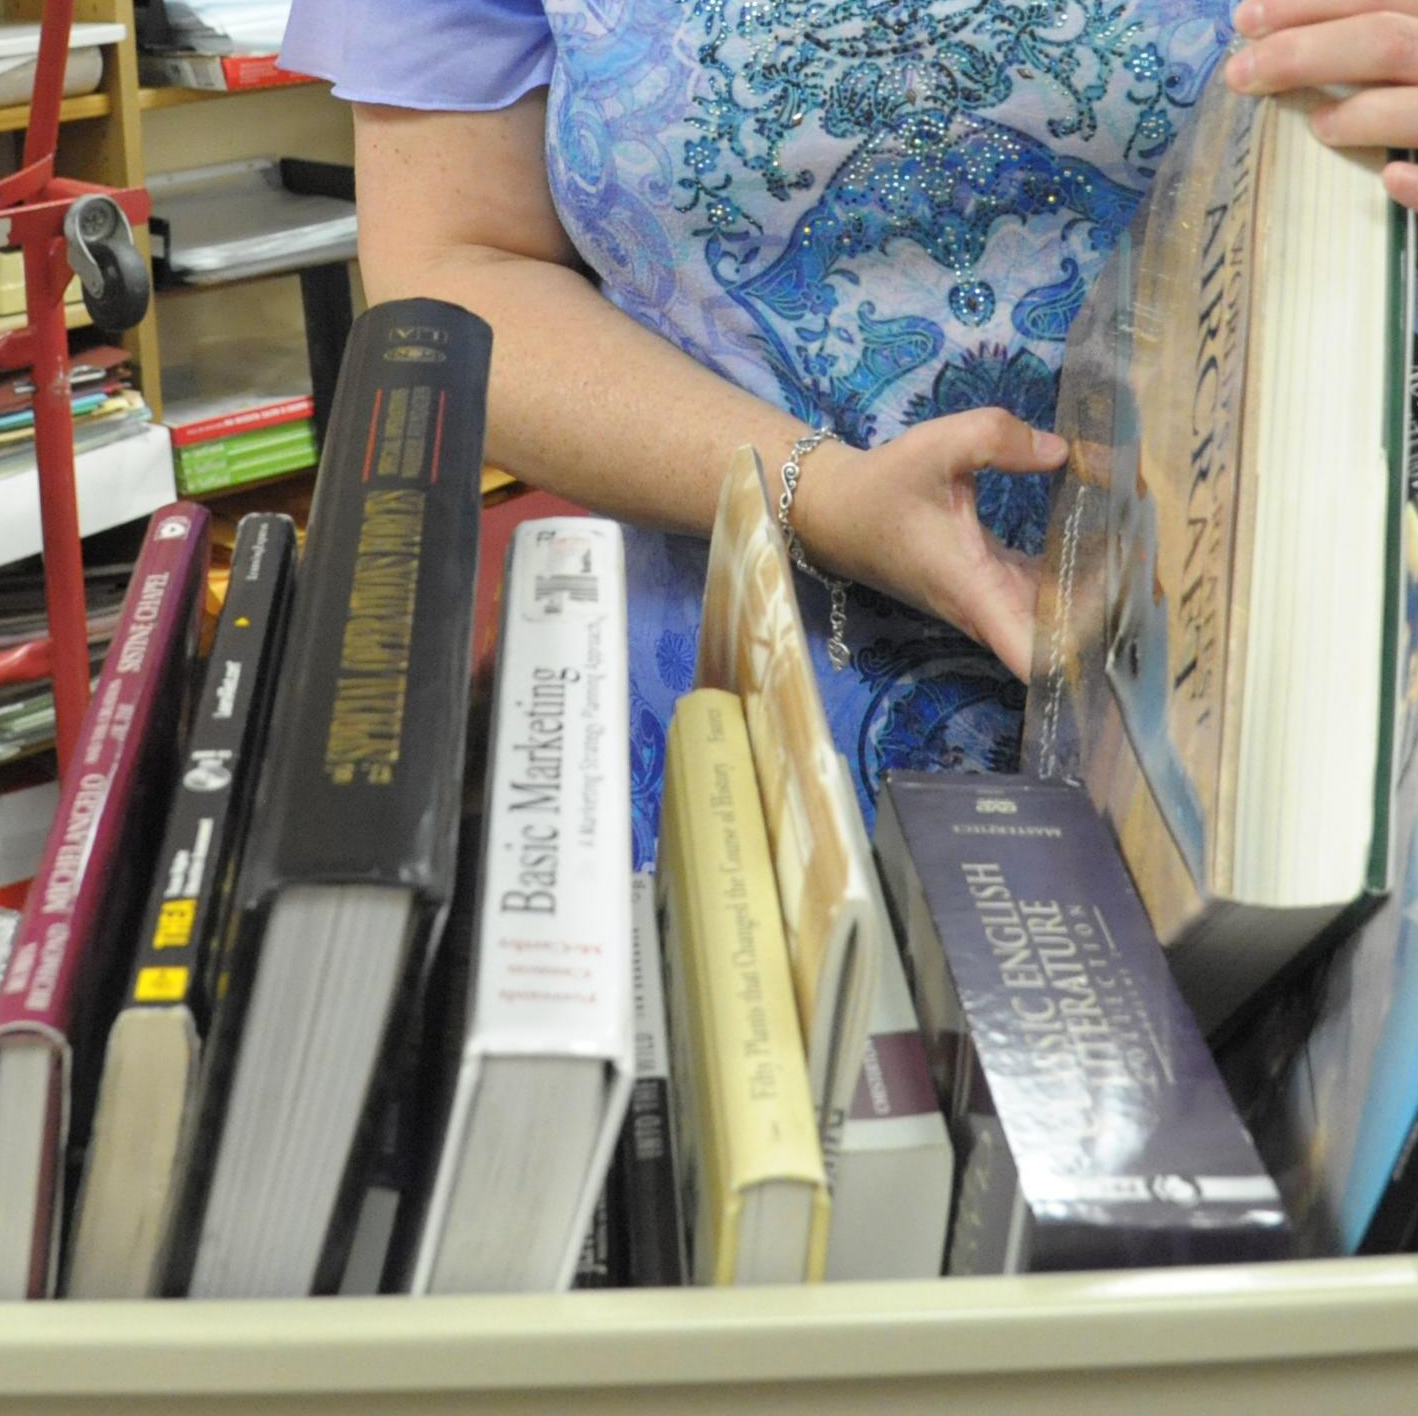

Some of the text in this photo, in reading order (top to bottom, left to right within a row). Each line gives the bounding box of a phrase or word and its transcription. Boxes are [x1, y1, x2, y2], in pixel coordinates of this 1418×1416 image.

[1173, 200, 1233, 690] AIRCRAFT
[1187, 124, 1254, 730] THE WORLD'S GREATEST
[118, 571, 169, 675] SISTINE CHAPEL
[590, 622, 608, 673] Approach
[585, 676, 607, 723] Planning
[582, 723, 608, 773] Strategy
[499, 667, 580, 916] Basic Marketing
[579, 775, 605, 837] Marketing
[700, 759, 738, 809] History
[42, 773, 108, 914] MICHELANGELO
[711, 825, 743, 875] Course
[719, 873, 747, 900] the
[153, 899, 197, 948] THEA
[722, 899, 764, 969] Changed
[962, 860, 1030, 989] ENGLISH
[24, 923, 69, 1011] RICHMOND
[734, 969, 764, 1003] that
[632, 1030, 655, 1072] WILD
[735, 1005, 773, 1059] Plants
[747, 1058, 786, 1101] Fifty
[633, 1113, 662, 1160] INTO
